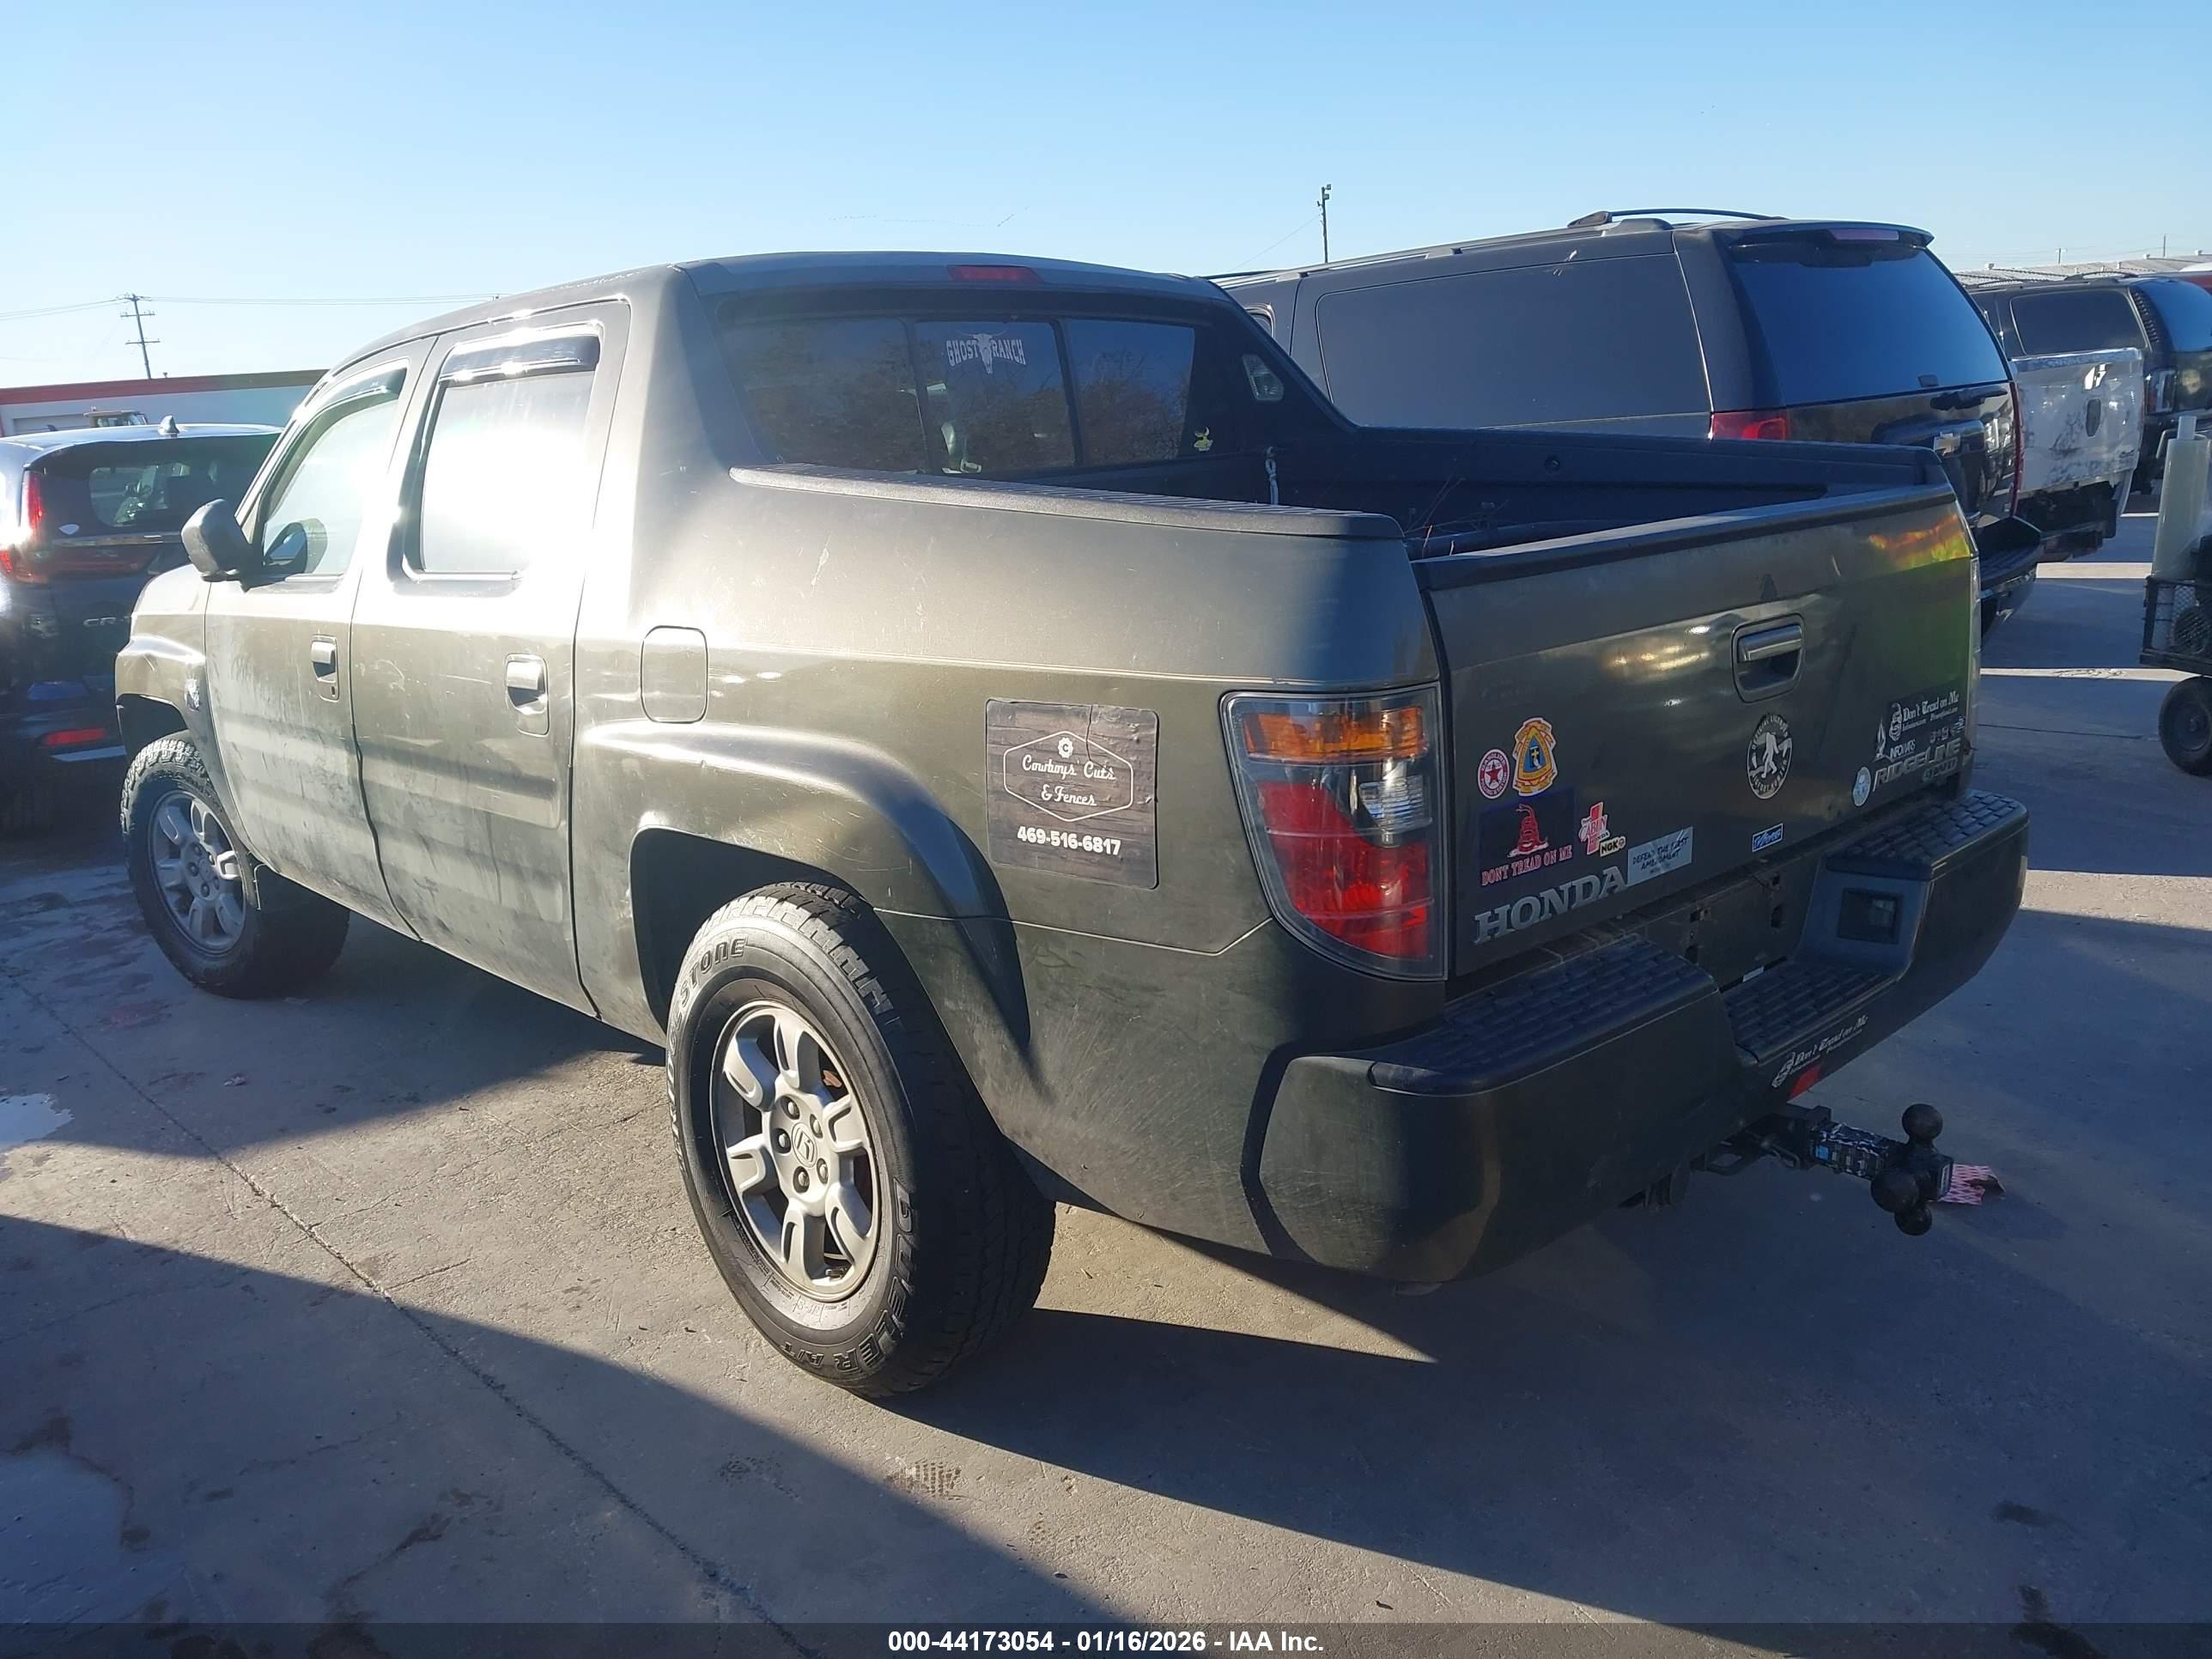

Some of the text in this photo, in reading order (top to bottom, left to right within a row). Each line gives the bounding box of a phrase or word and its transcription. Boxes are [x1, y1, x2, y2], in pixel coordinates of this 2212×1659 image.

[945, 339, 1026, 367] GHOST RANCH
[1084, 760, 1116, 781] Cuts
[1872, 737, 1961, 793] RIDGELINE
[1041, 784, 1097, 806] & Fences
[1017, 825, 1121, 855] 469-516-6817
[1601, 839, 1619, 854] NGK
[1481, 844, 1572, 886] DONT TREAD ON ME
[1473, 866, 1628, 944] HONDA
